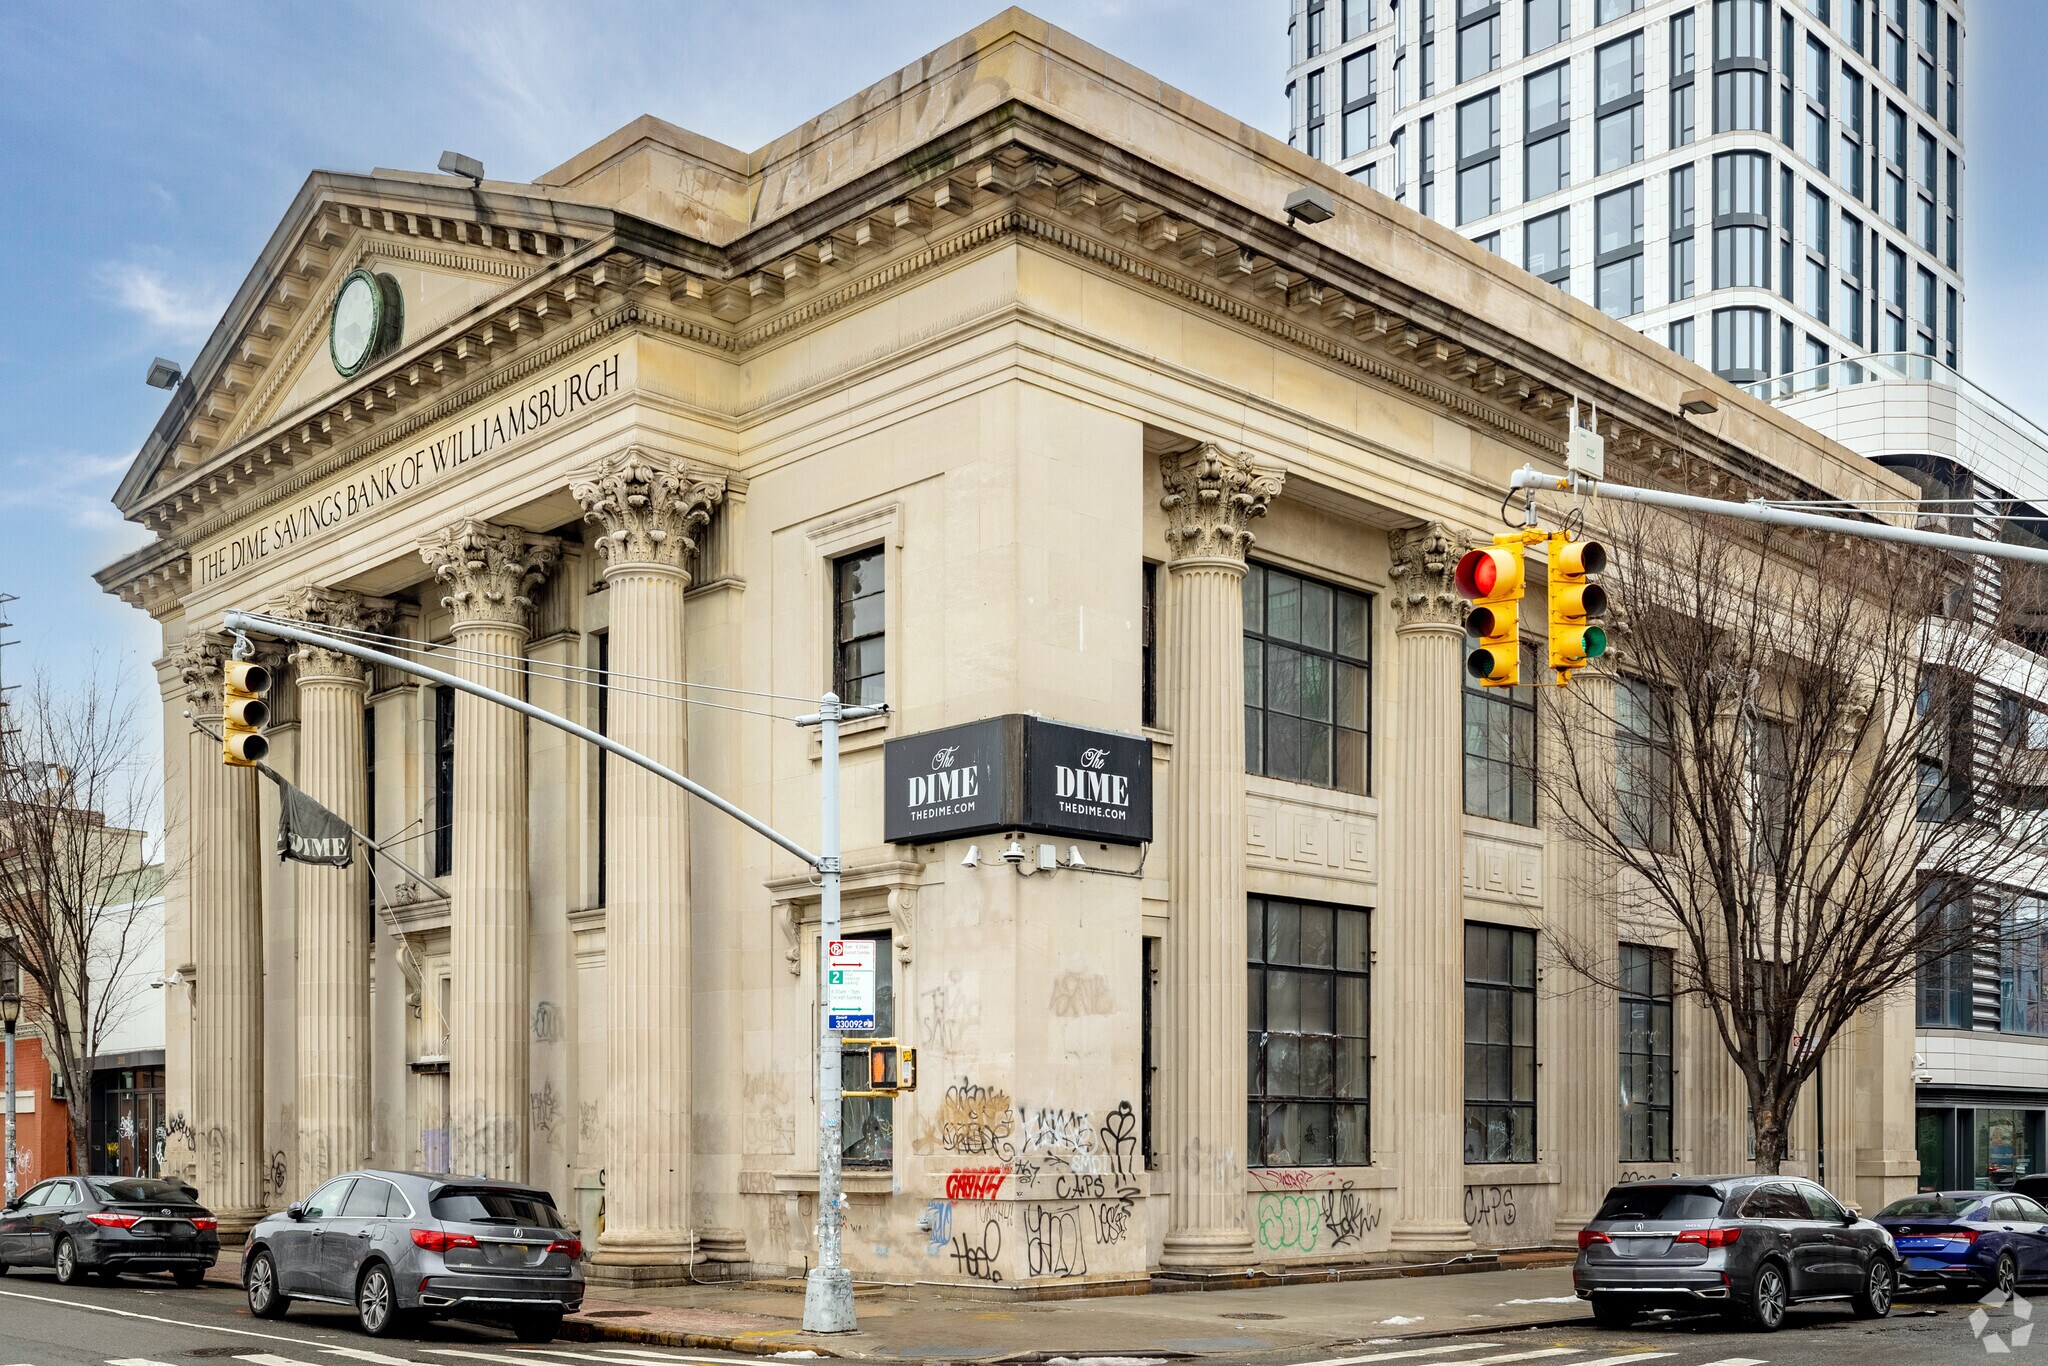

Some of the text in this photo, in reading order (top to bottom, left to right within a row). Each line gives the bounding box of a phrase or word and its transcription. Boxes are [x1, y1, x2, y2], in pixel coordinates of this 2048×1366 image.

[199, 354, 619, 585] THE DIME SAVINGS BANK OF WILLIAMSBURGH
[932, 745, 960, 771] The
[1081, 748, 1111, 769] The
[907, 765, 979, 808] DIME
[1055, 765, 1129, 807] DIME
[911, 801, 975, 821] THEDIME.COM
[1059, 801, 1126, 820] THEDIME.COM
[287, 833, 347, 857] DIME
[832, 971, 840, 984] 2
[835, 1020, 863, 1028] 330092
[1056, 1174, 1105, 1199] CAPS
[1464, 1185, 1517, 1226] CAPS
